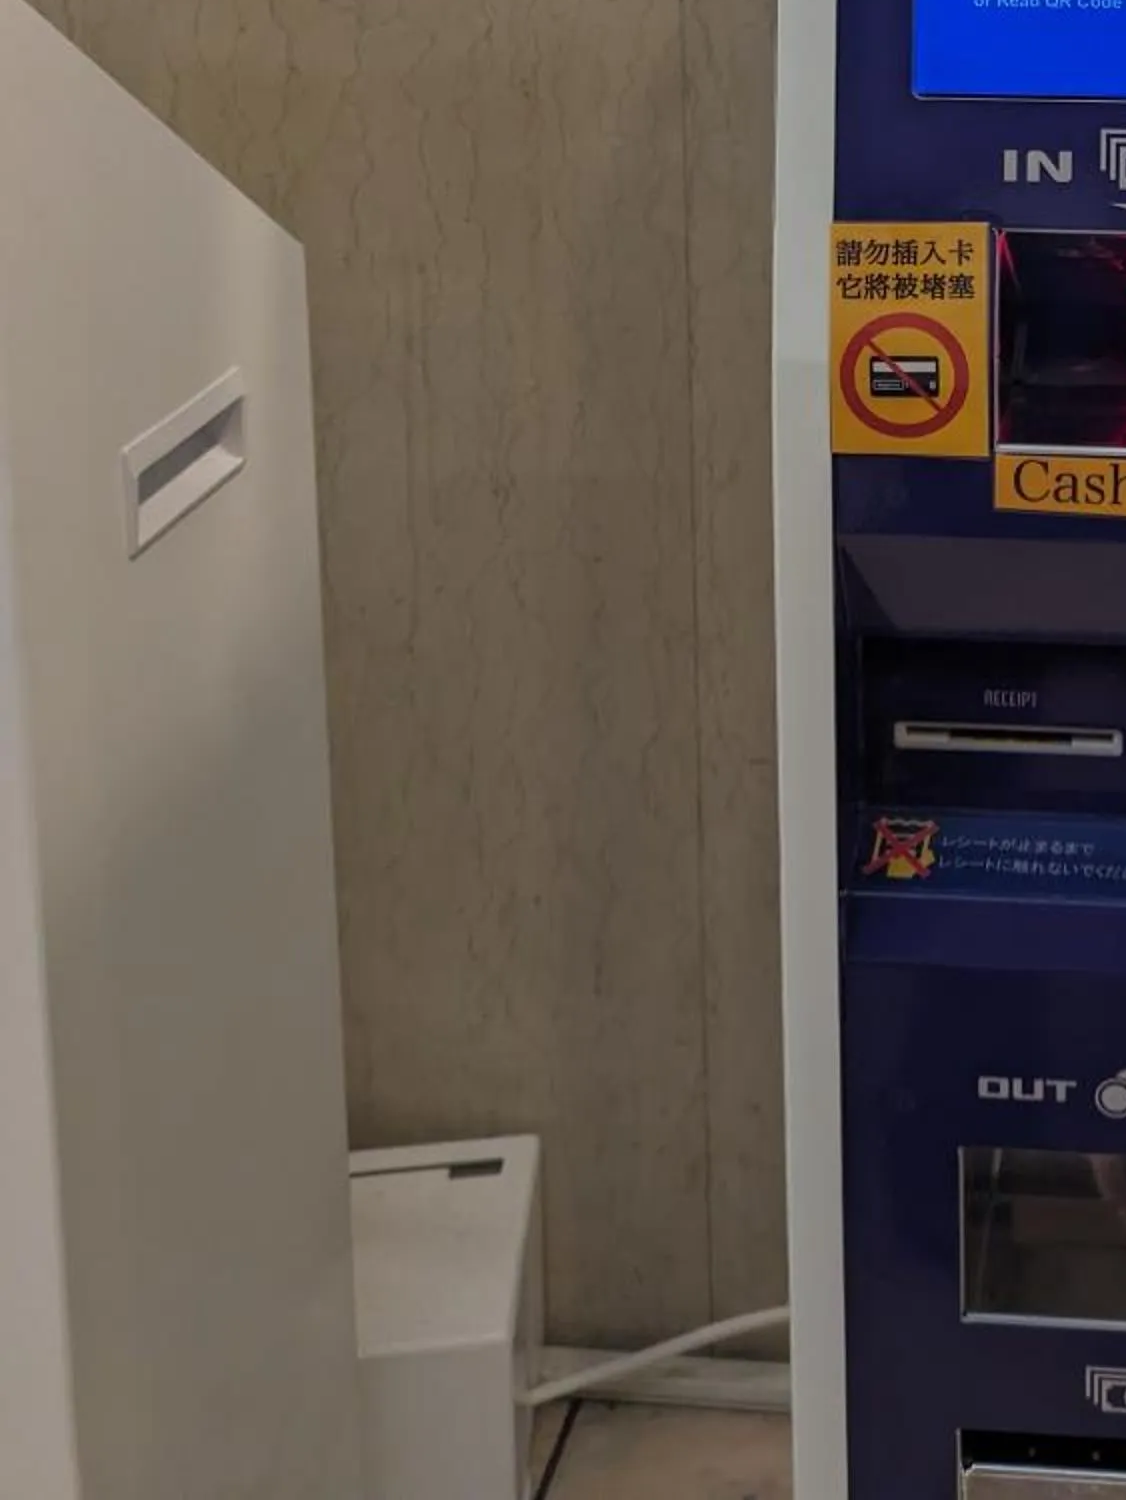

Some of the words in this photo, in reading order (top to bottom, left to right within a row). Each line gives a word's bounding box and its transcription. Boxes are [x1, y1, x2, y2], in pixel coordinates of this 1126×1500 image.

[1003, 149, 1073, 183] IN
[836, 239, 974, 266] 請勿插入卡
[836, 272, 975, 300] 它將被堵塞
[983, 689, 1037, 708] RECEIPT
[977, 1075, 1077, 1102] OUT
